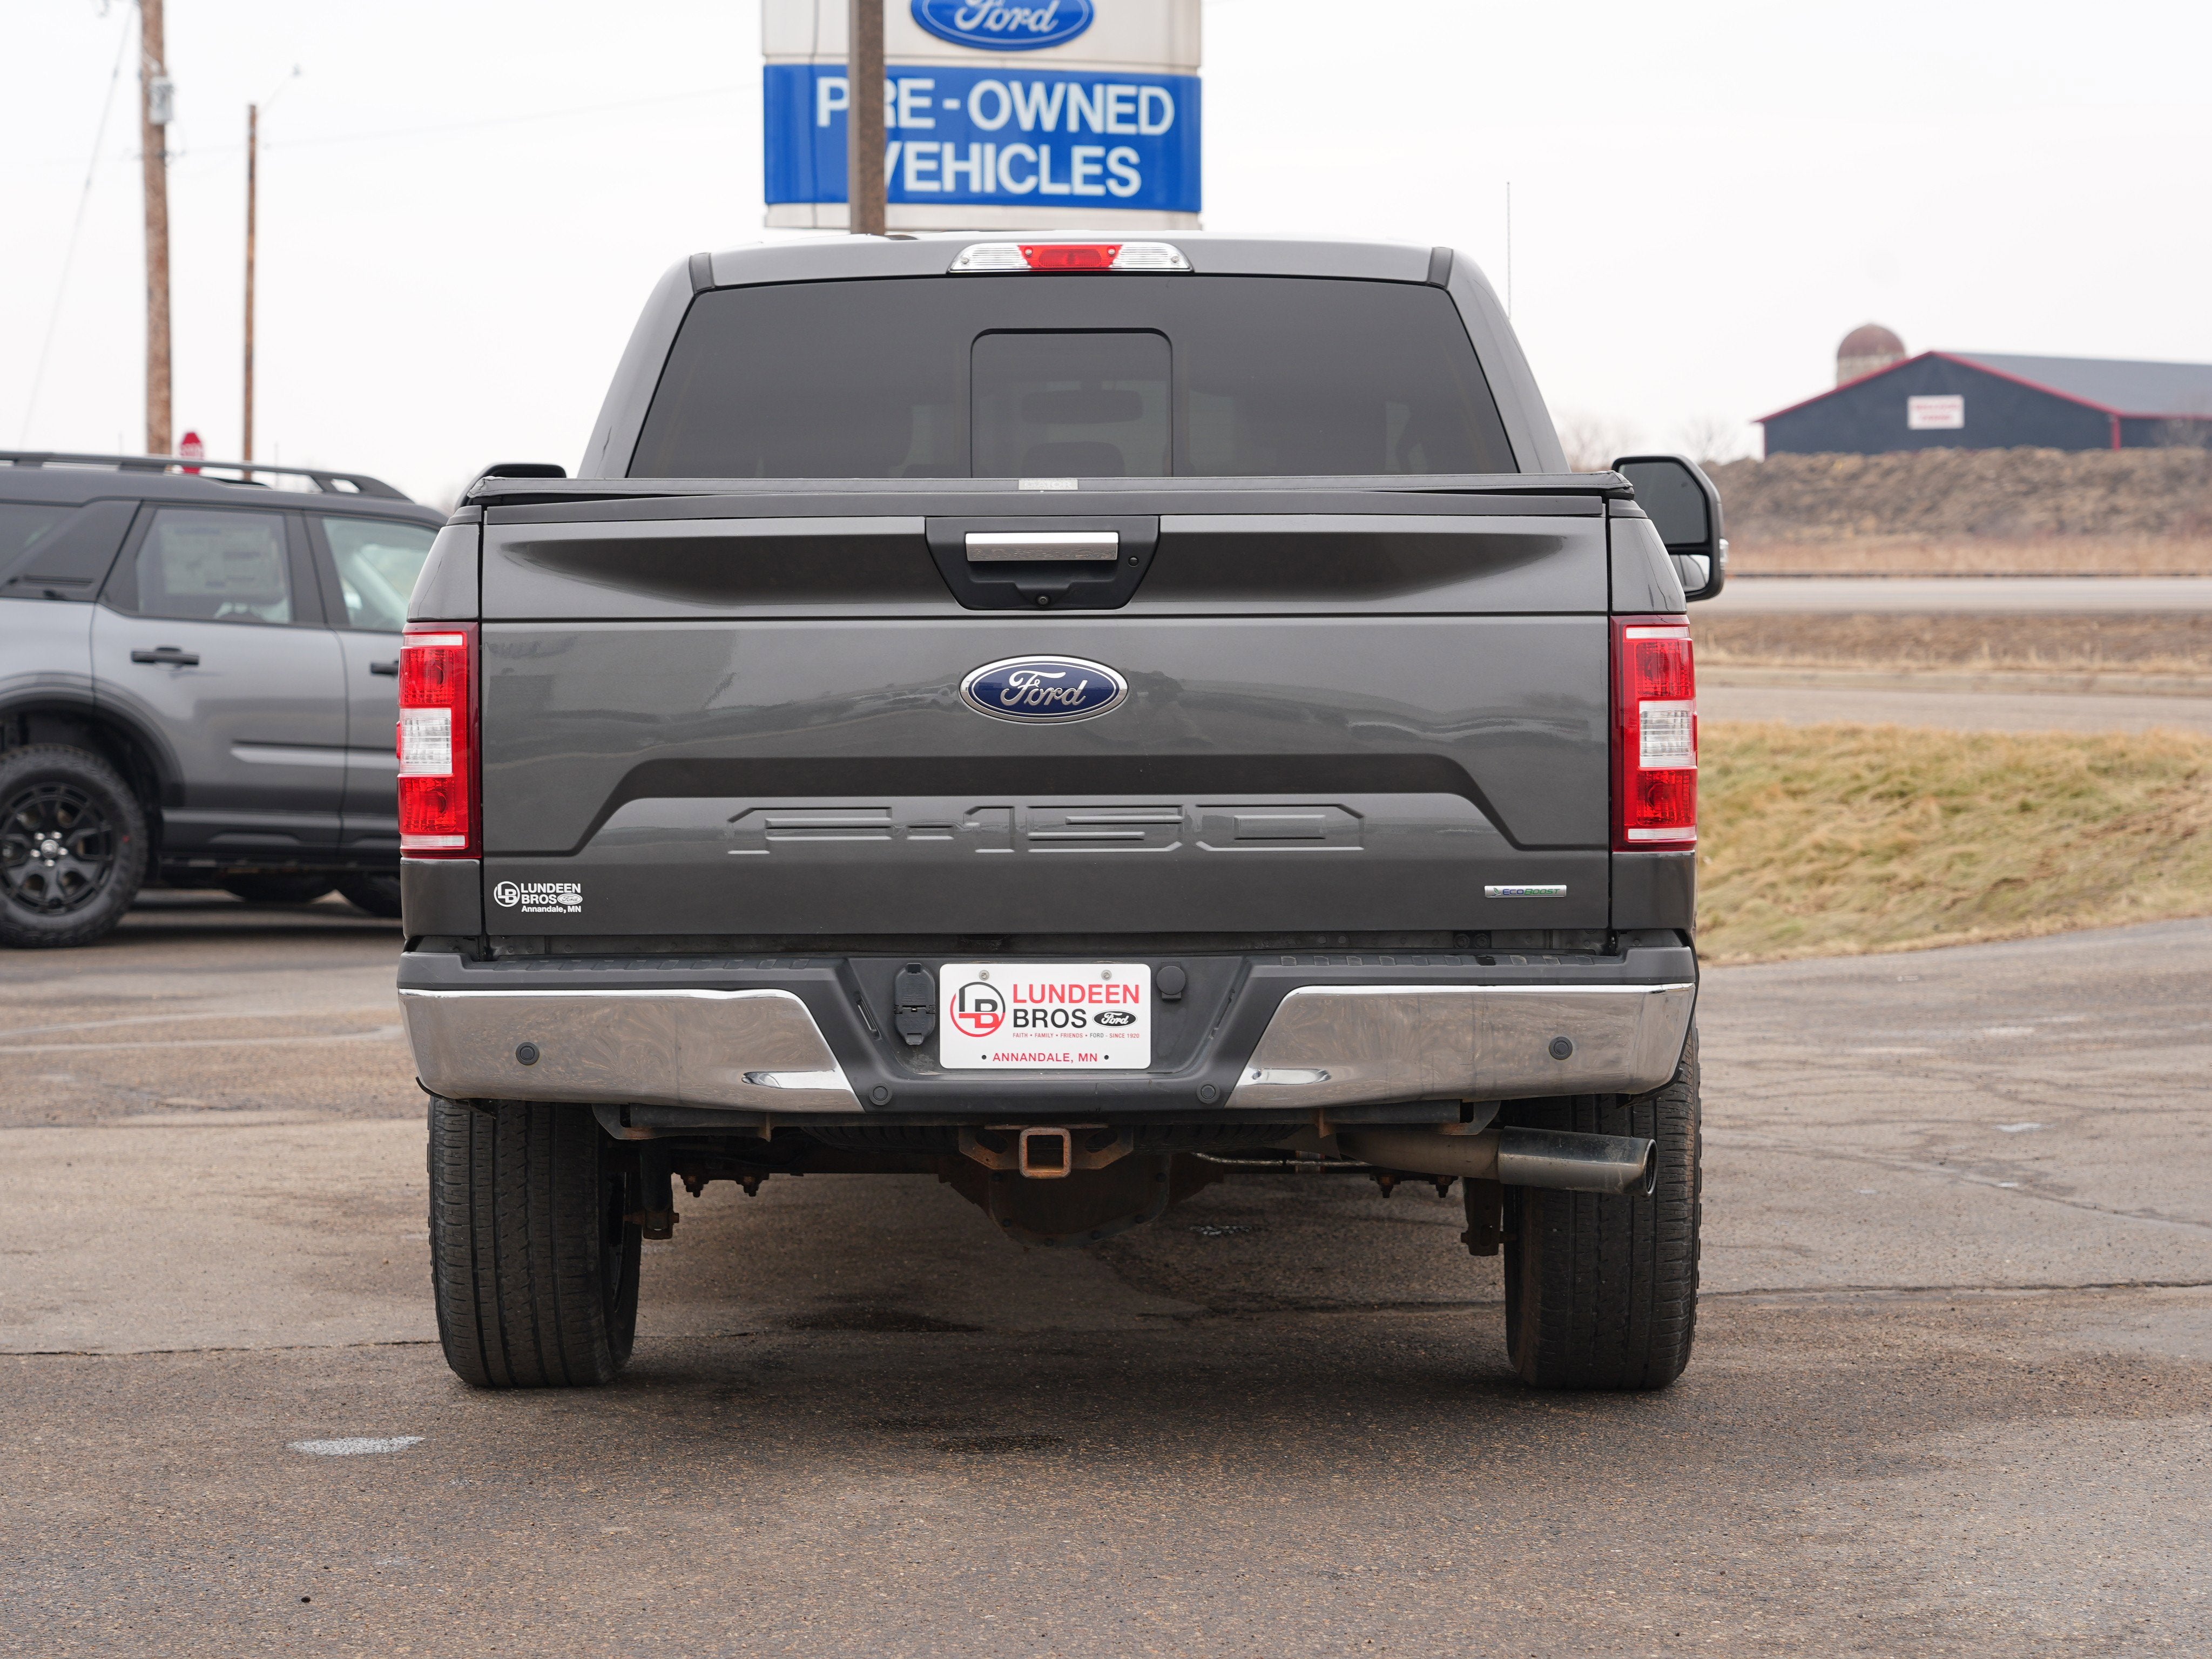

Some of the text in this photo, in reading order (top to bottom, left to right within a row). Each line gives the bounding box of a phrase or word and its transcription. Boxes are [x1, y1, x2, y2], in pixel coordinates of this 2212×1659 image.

[954, 0, 1059, 32] Ford
[817, 76, 1175, 136] PE-OWNED
[1000, 670, 1088, 706] Ford
[521, 883, 581, 893] LUNDEEN
[521, 894, 557, 905] BROS
[521, 905, 567, 914] Annandale,
[1013, 984, 1139, 1004] LUNDEEN
[1013, 1008, 1087, 1028] BROS
[1101, 1012, 1129, 1025] Ford
[993, 1053, 1098, 1063] ANNANDALE, MN
